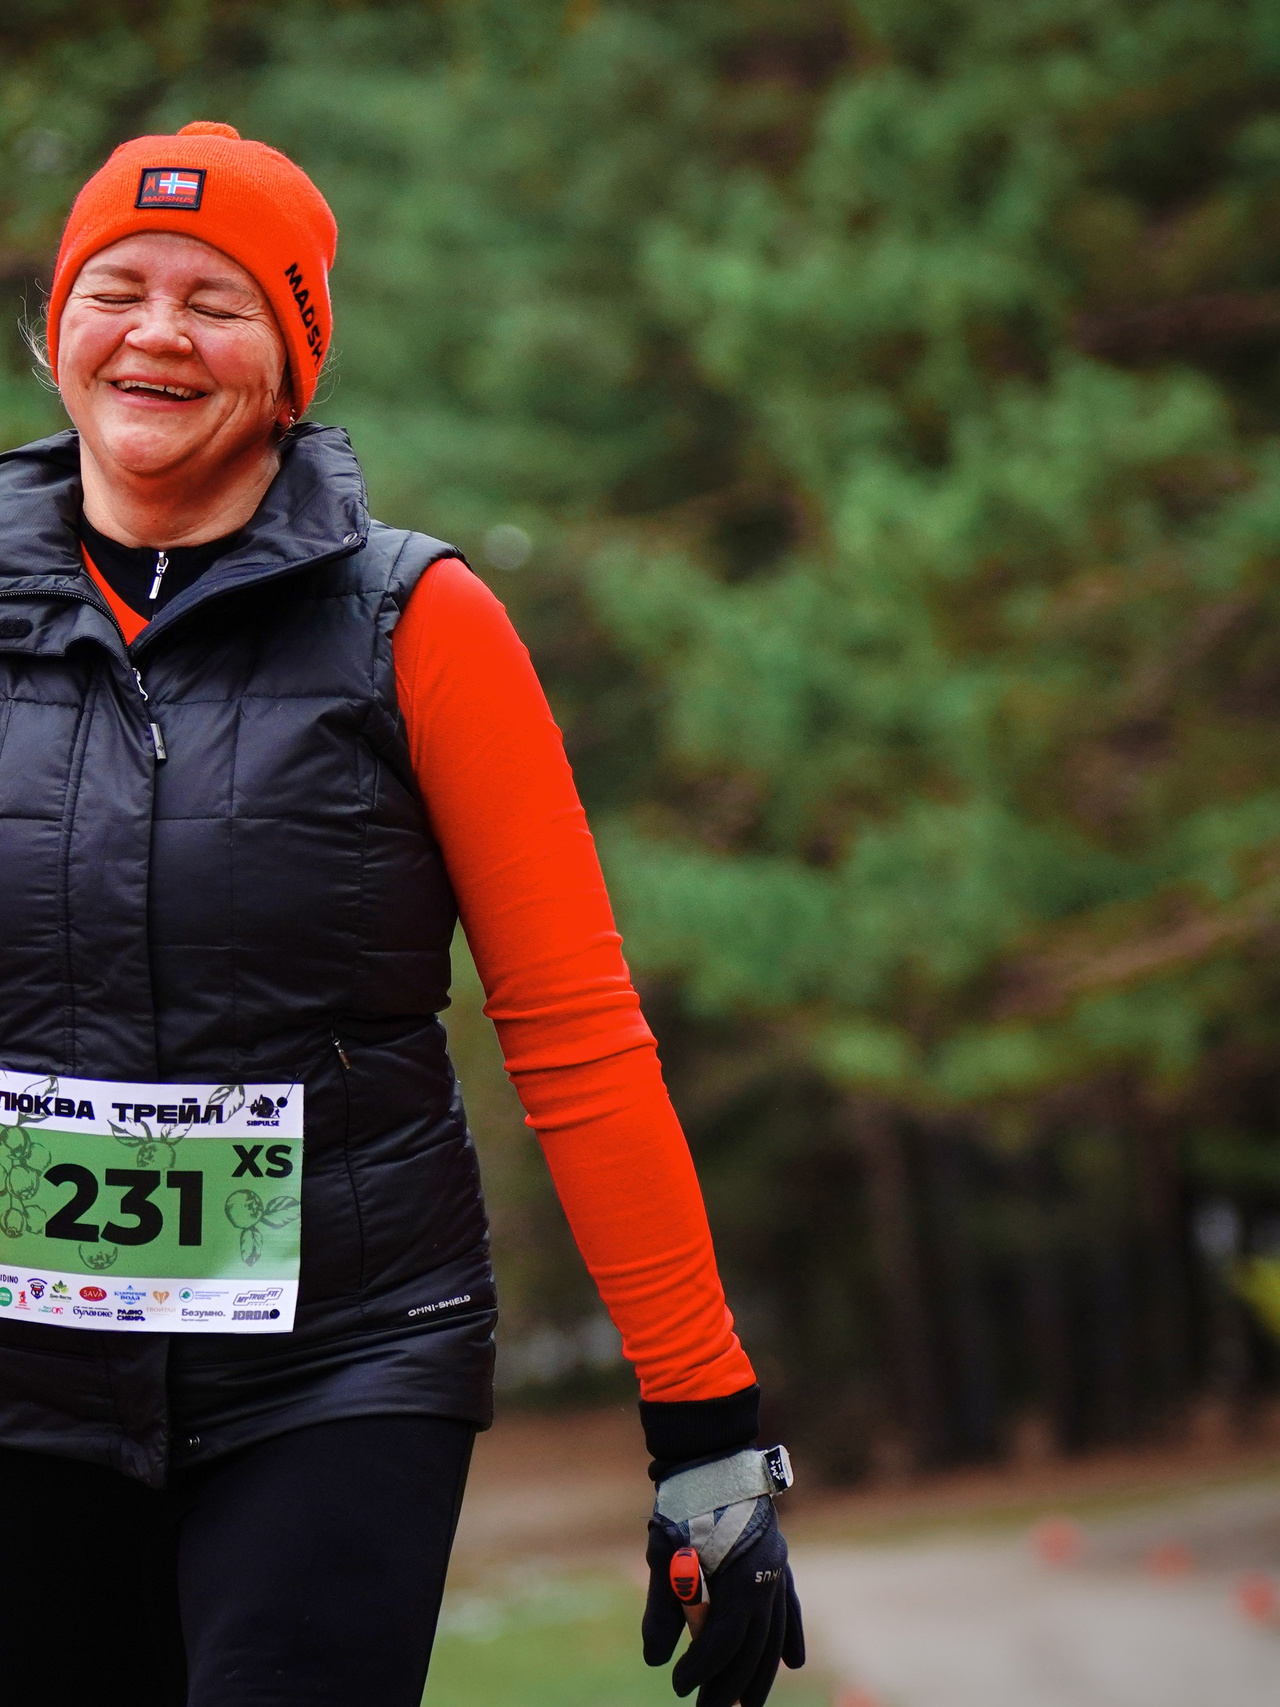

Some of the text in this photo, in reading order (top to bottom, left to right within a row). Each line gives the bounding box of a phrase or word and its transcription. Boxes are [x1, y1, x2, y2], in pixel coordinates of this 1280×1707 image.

[142, 195, 195, 204] MADSHUS
[111, 1098, 224, 1124] ТРЕЙЛ
[231, 1144, 294, 1179] XS
[43, 1163, 204, 1247] 231
[117, 1308, 143, 1316] РАДИО
[181, 1308, 226, 1318] Безумно.
[407, 1294, 471, 1317] OMNI-SHIELD
